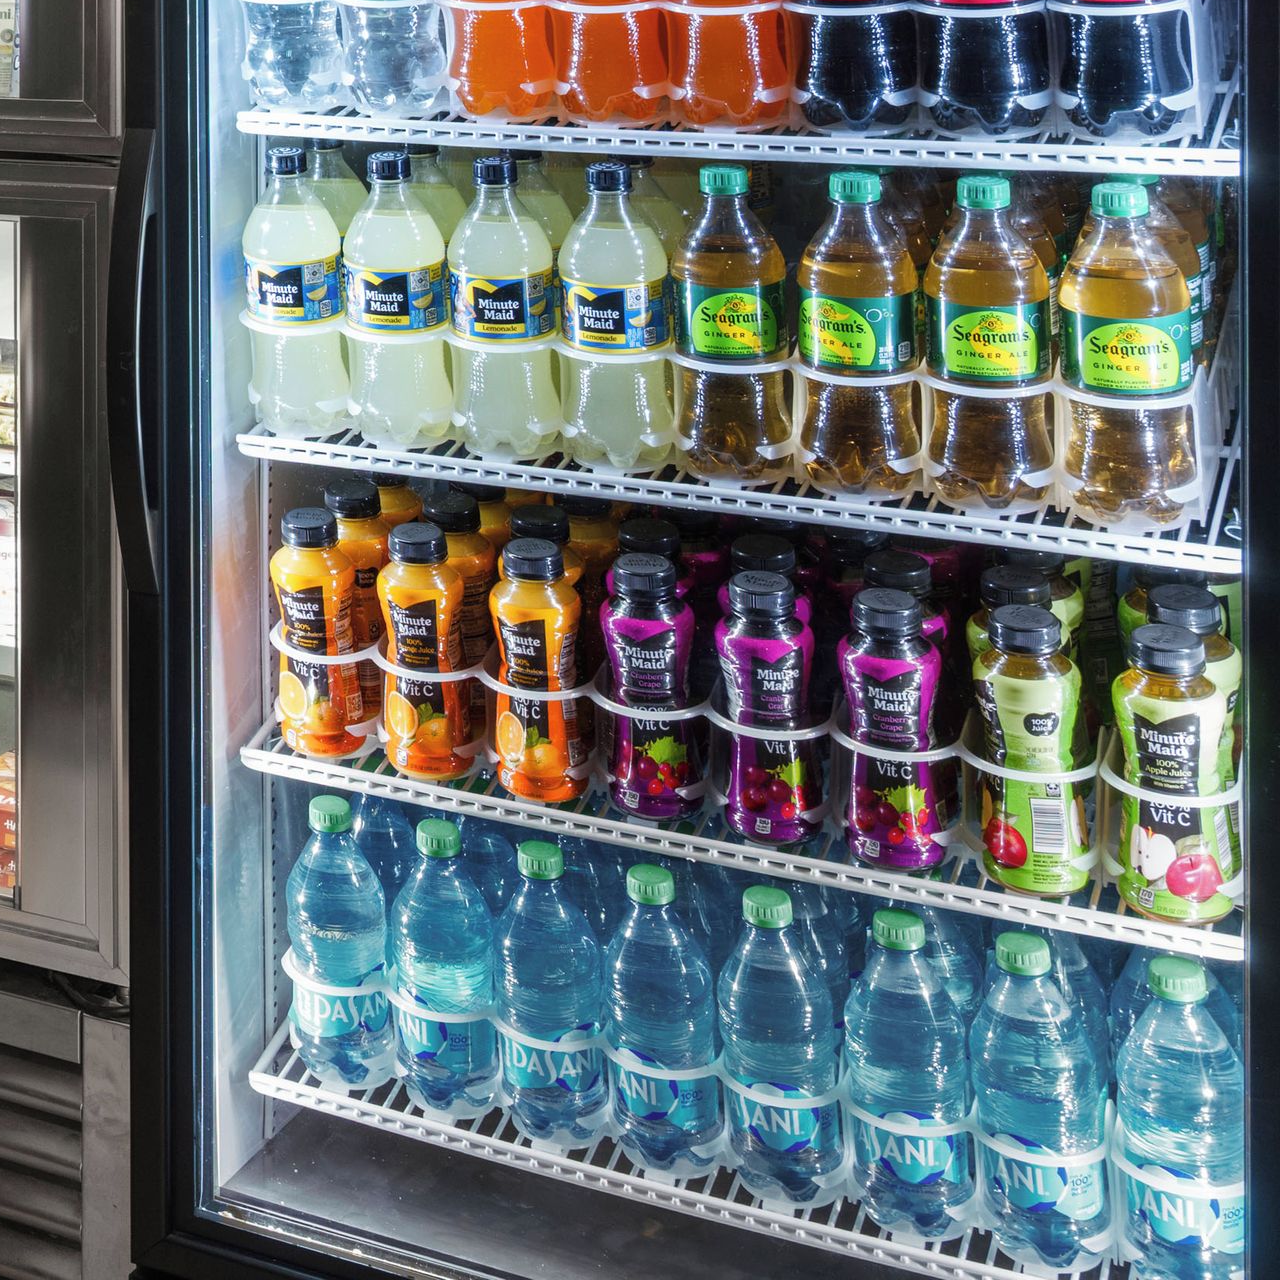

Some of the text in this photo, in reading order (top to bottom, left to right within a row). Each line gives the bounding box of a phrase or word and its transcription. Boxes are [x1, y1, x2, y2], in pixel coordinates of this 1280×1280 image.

[262, 282, 298, 295] Minute
[266, 292, 293, 305] Maid
[365, 290, 403, 303] Minute
[370, 300, 398, 313] Maid
[478, 298, 519, 311] Minute
[484, 307, 514, 320] Maid
[482, 324, 518, 333] Lemonade
[952, 324, 1030, 346] Seagram's
[956, 349, 1002, 359] GINGER
[1089, 336, 1170, 359] Seagram's
[1093, 362, 1140, 372] GINGER
[293, 660, 308, 673] Vit
[880, 723, 903, 732] Grape
[765, 741, 785, 755] Vit
[1156, 759, 1179, 768] 100%
[1146, 766, 1192, 777] Apple Juice
